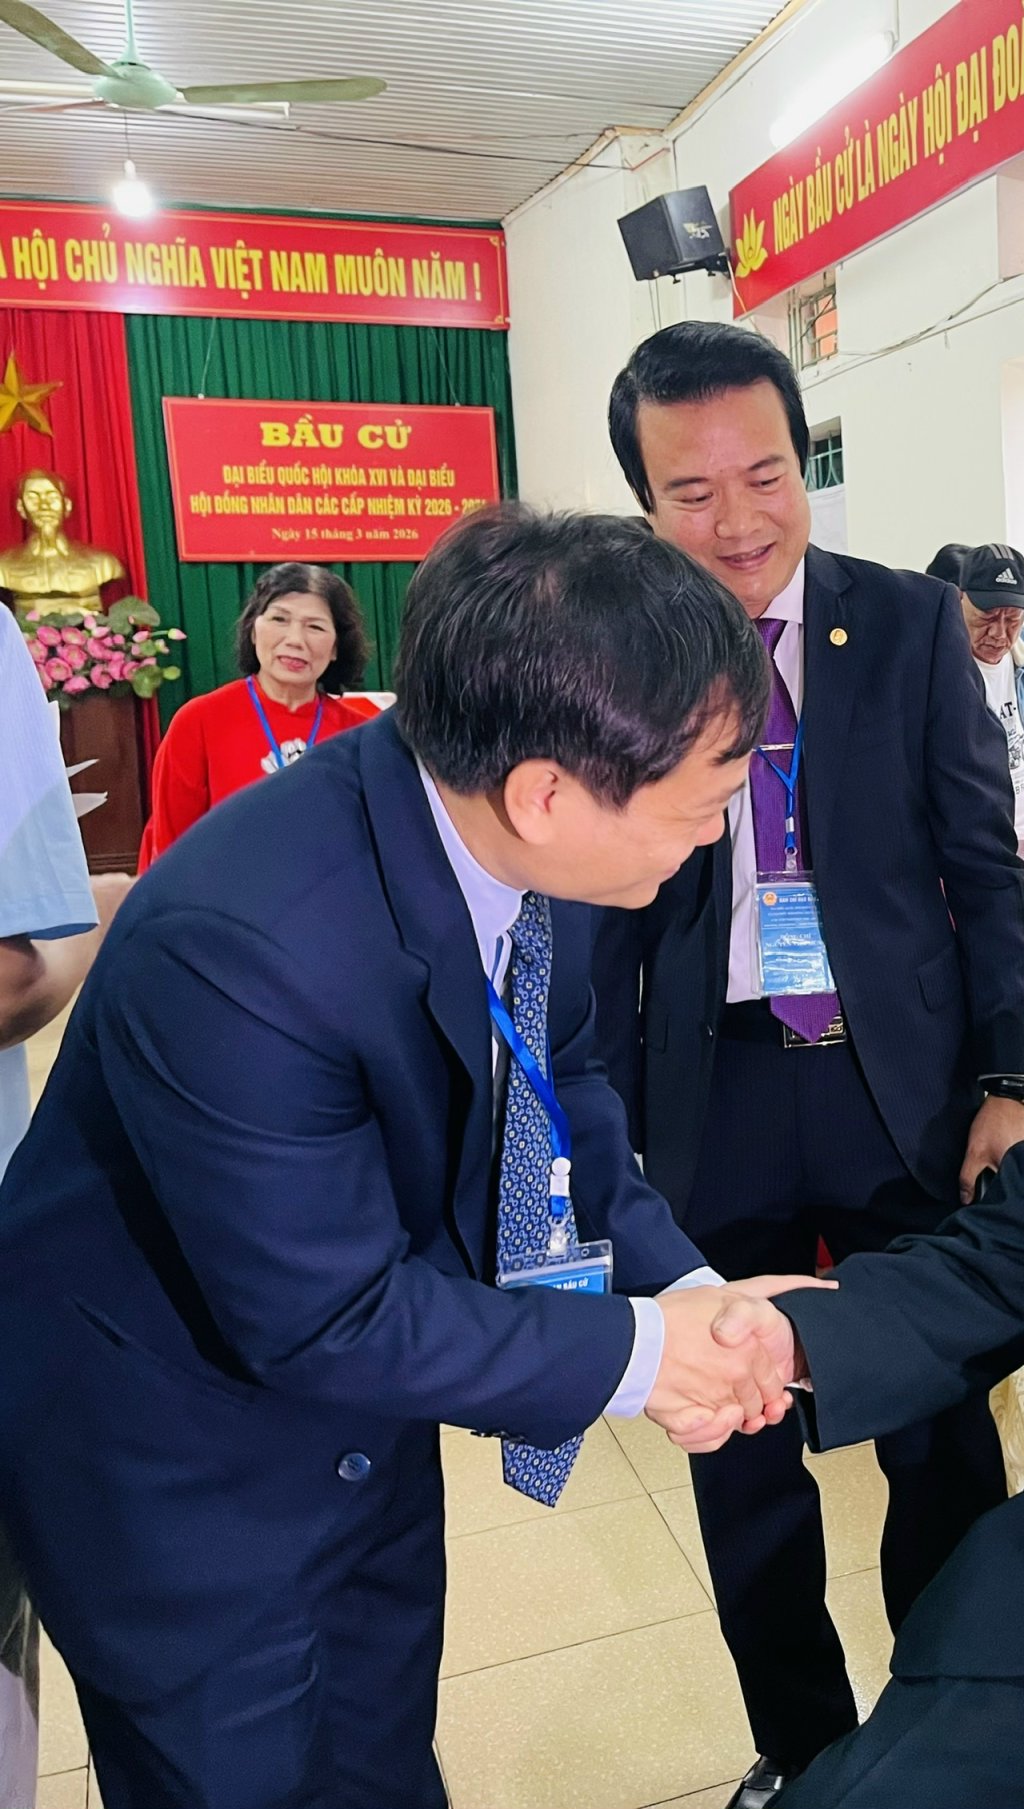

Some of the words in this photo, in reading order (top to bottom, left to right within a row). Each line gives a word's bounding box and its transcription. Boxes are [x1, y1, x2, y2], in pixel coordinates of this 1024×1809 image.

[773, 176, 804, 255] NGÀY
[806, 146, 833, 235] BẦU
[835, 125, 855, 215] CỬ
[856, 119, 876, 202] LÀ
[877, 92, 918, 187] NGÀY
[922, 63, 953, 166] HỘI
[956, 46, 988, 144] ĐẠI
[12, 228, 59, 290] HỘI
[64, 222, 119, 284] CHỦ
[124, 237, 207, 288] NGHĨA
[210, 240, 263, 300] VIỆT
[270, 250, 329, 294] NAM
[334, 248, 407, 298] MUÔN
[412, 251, 467, 301] NĂM
[260, 413, 344, 448] BẦU
[357, 419, 412, 450] CỬ
[223, 465, 245, 488] ĐẠI
[247, 459, 275, 485] BIỂU
[277, 460, 310, 487] QUỐC
[312, 463, 333, 489] HỘI
[368, 468, 388, 487] XVI
[390, 465, 406, 487] VÀ
[407, 468, 428, 491] ĐẠI
[429, 462, 456, 488] BIỂU
[190, 491, 212, 517] HỘI
[214, 489, 249, 514] ĐỒNG
[250, 492, 285, 515] NHÂN
[287, 493, 313, 515] DÂN
[315, 493, 339, 516] CÁC
[341, 491, 366, 515] CẤP
[367, 493, 405, 520] NHIỆM
[407, 494, 422, 516] KỲ
[424, 498, 453, 516] 2026
[272, 528, 301, 542] Ngày
[305, 528, 319, 540] 15
[321, 528, 354, 542] tháng
[355, 528, 363, 540] 3
[365, 528, 390, 540] năm
[393, 528, 420, 540] 2026
